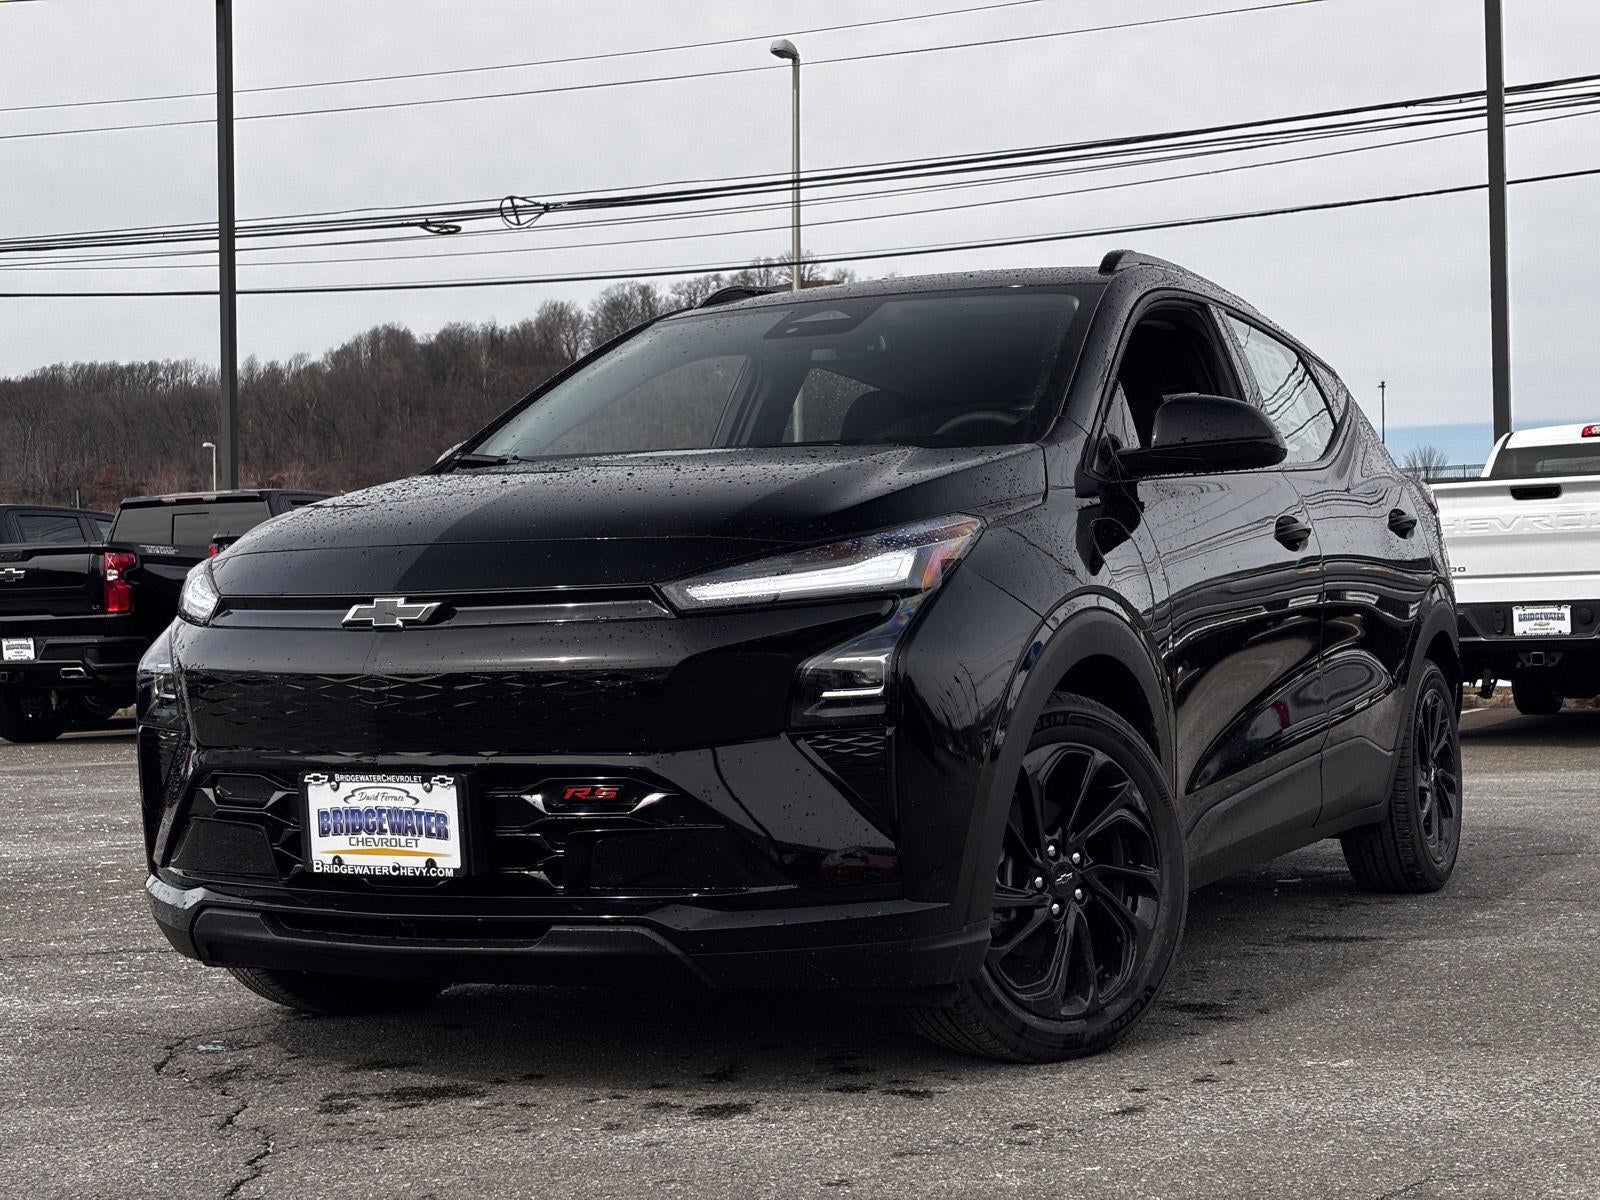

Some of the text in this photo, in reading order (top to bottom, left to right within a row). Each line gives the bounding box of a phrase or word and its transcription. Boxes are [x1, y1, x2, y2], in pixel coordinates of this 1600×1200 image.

[1518, 612, 1566, 622] BRIDGEWATER
[358, 792, 380, 802] David
[564, 787, 620, 800] RS
[317, 806, 451, 841] BRIDGEWATER
[349, 837, 421, 848] CHEVROLET
